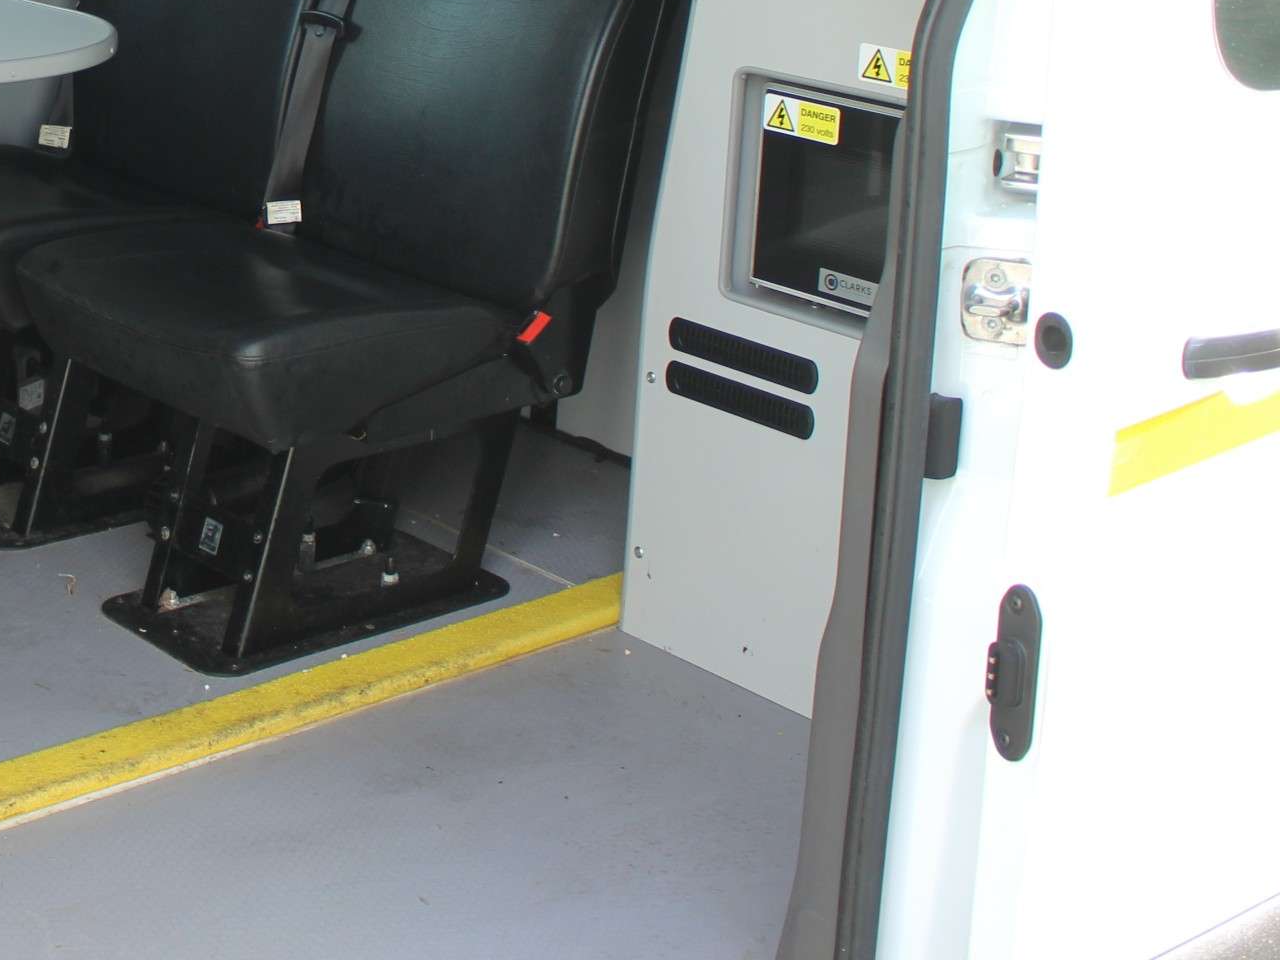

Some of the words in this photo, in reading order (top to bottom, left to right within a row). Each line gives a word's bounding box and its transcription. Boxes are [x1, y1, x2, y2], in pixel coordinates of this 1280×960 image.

[801, 108, 836, 123] DANGER
[801, 123, 815, 134] 230
[816, 126, 834, 138] volts
[840, 279, 873, 296] CLARKS
